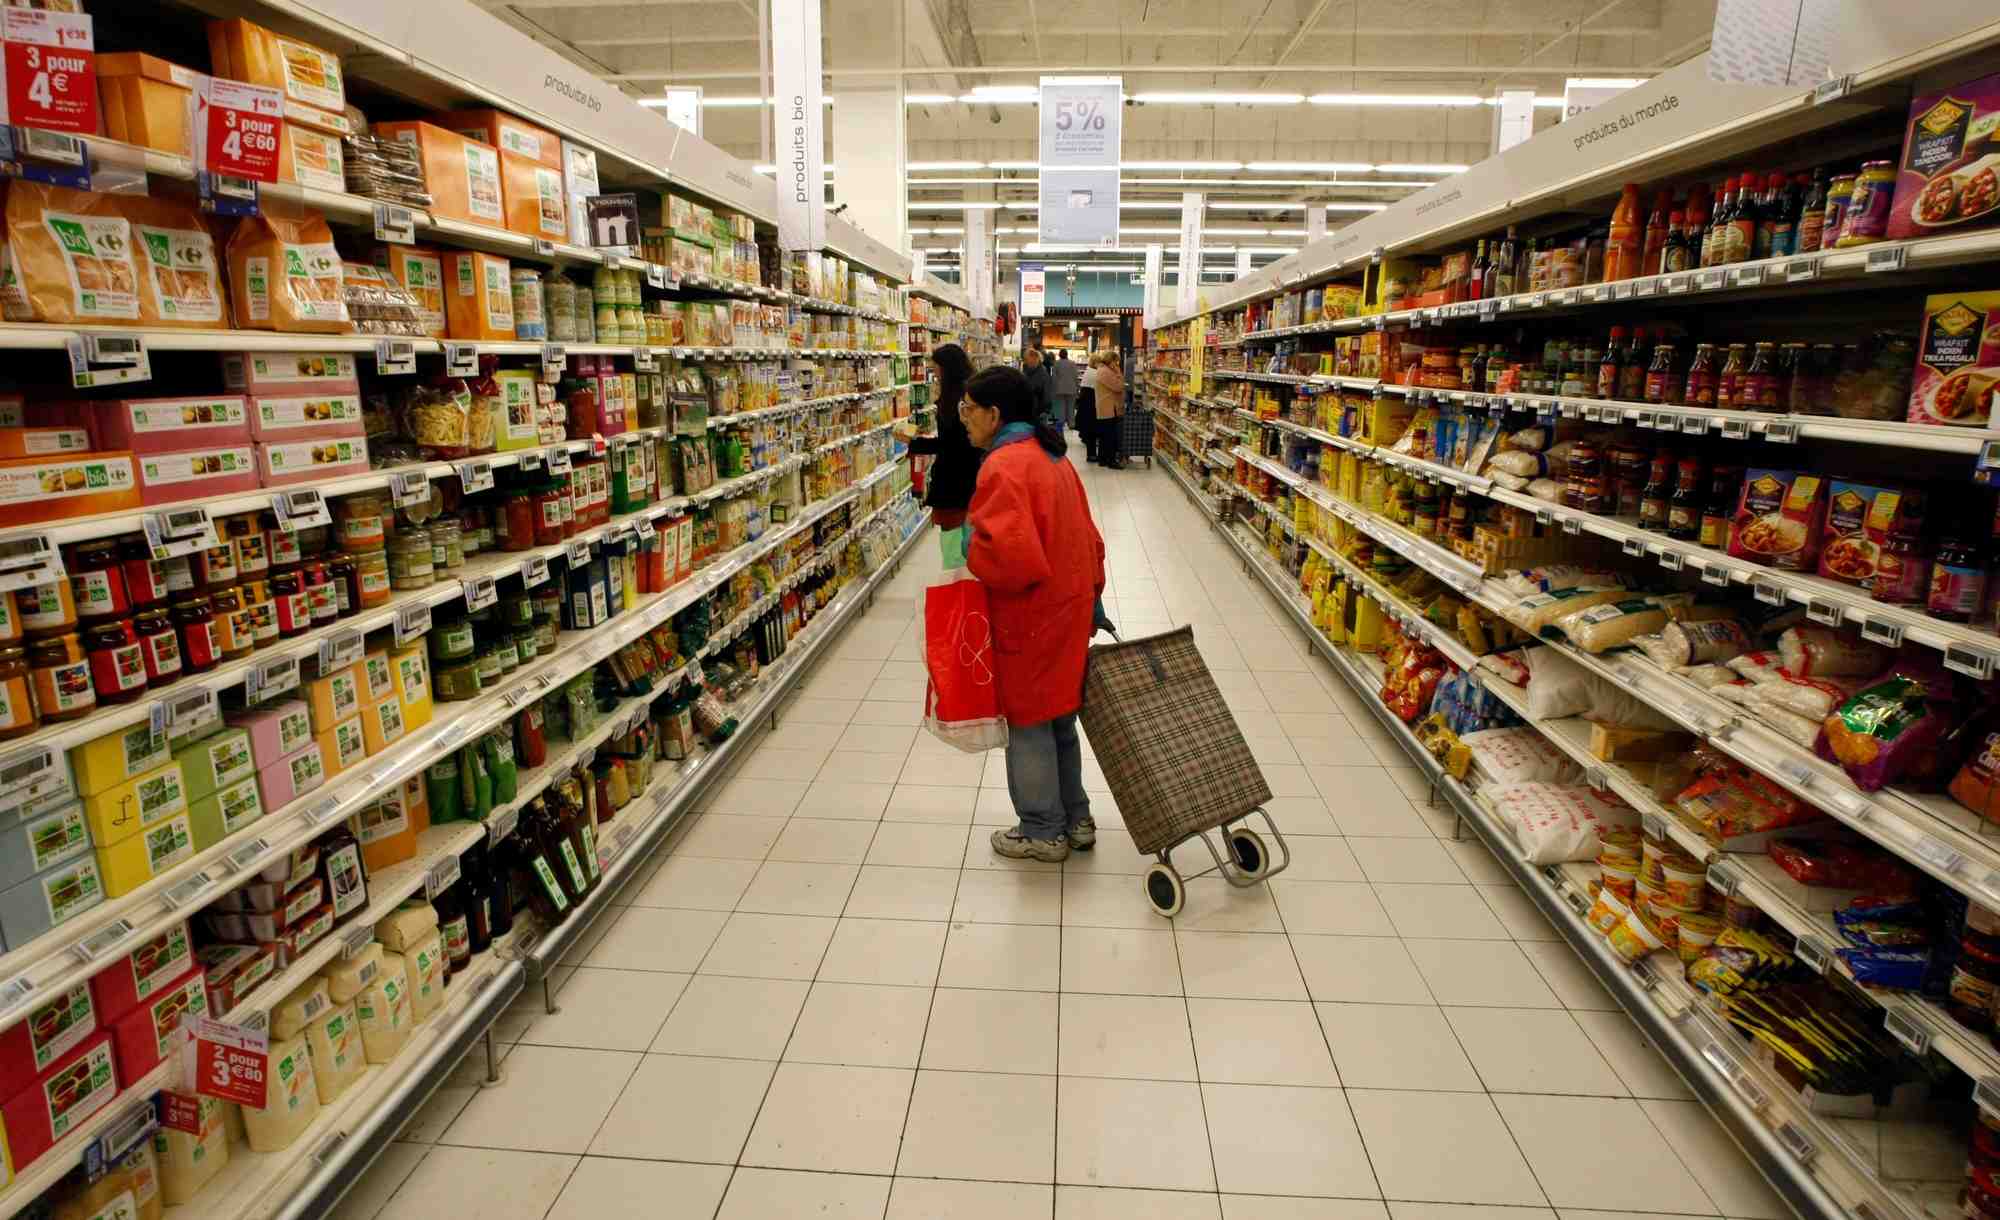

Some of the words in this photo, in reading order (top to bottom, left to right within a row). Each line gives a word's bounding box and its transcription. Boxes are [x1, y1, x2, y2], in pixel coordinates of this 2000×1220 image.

[26, 47, 40, 69] 3
[47, 56, 86, 73] pour
[792, 95, 804, 121] bio
[1056, 101, 1105, 131] 5%
[225, 110, 237, 128] 3
[241, 119, 274, 134] pour
[1574, 121, 1619, 152] produits
[1619, 114, 1635, 129] du
[1635, 95, 1680, 122] monde
[222, 130, 276, 160] 4€60
[792, 126, 809, 202] produits
[88, 469, 106, 486] bio
[214, 1045, 225, 1060] 2
[229, 1053, 260, 1067] pour
[211, 1061, 263, 1087] 3€80
